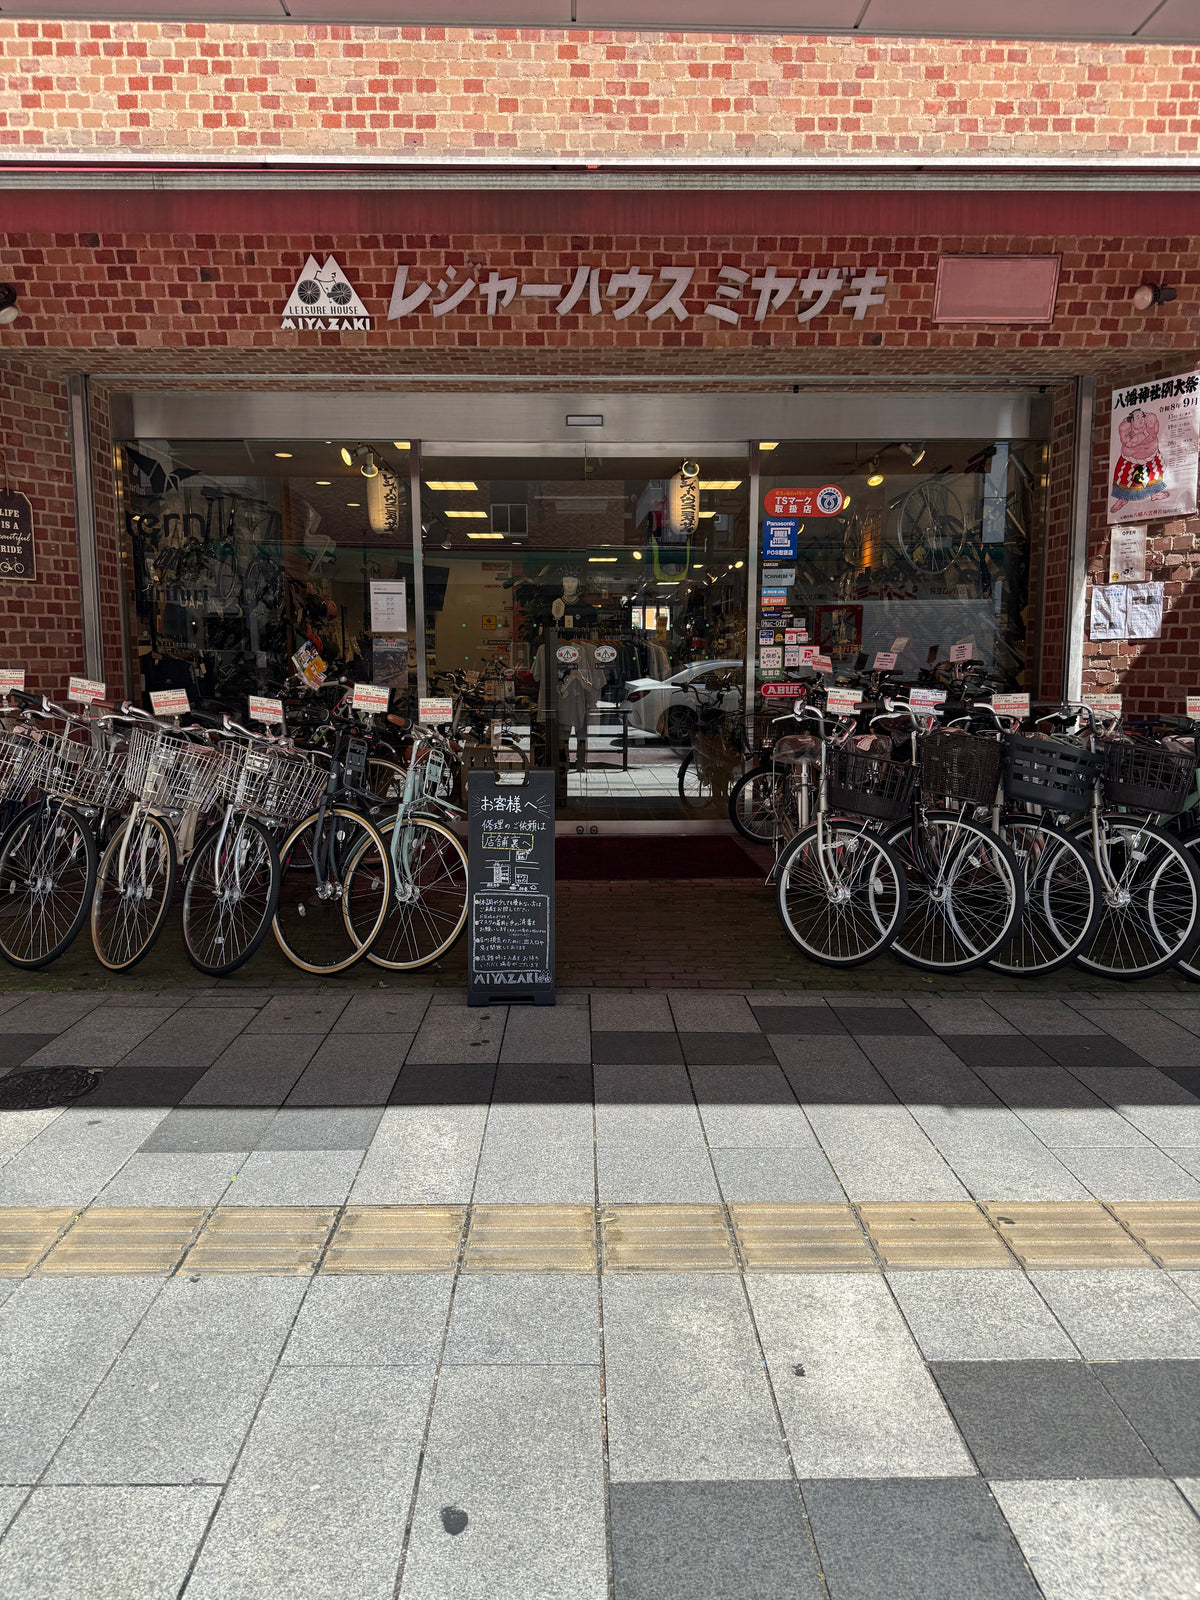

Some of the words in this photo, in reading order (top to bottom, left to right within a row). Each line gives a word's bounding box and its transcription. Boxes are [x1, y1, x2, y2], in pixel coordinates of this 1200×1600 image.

[289, 305, 328, 315] LEISURE
[330, 305, 359, 315] HOUSE
[281, 317, 371, 331] MIYAZAKI
[1114, 375, 1199, 410] 八幡神社例大祭
[775, 496, 811, 505] TSマーク
[0, 509, 20, 518] LIFE
[775, 505, 812, 514] 取扱店
[1, 520, 11, 529] IS
[13, 521, 20, 530] A
[0, 544, 23, 554] RIDE
[767, 685, 802, 695] ABUS
[481, 795, 537, 813] お客様へ
[482, 818, 546, 832] 修理のご依頼は
[474, 972, 540, 985] MIYAZAKI
